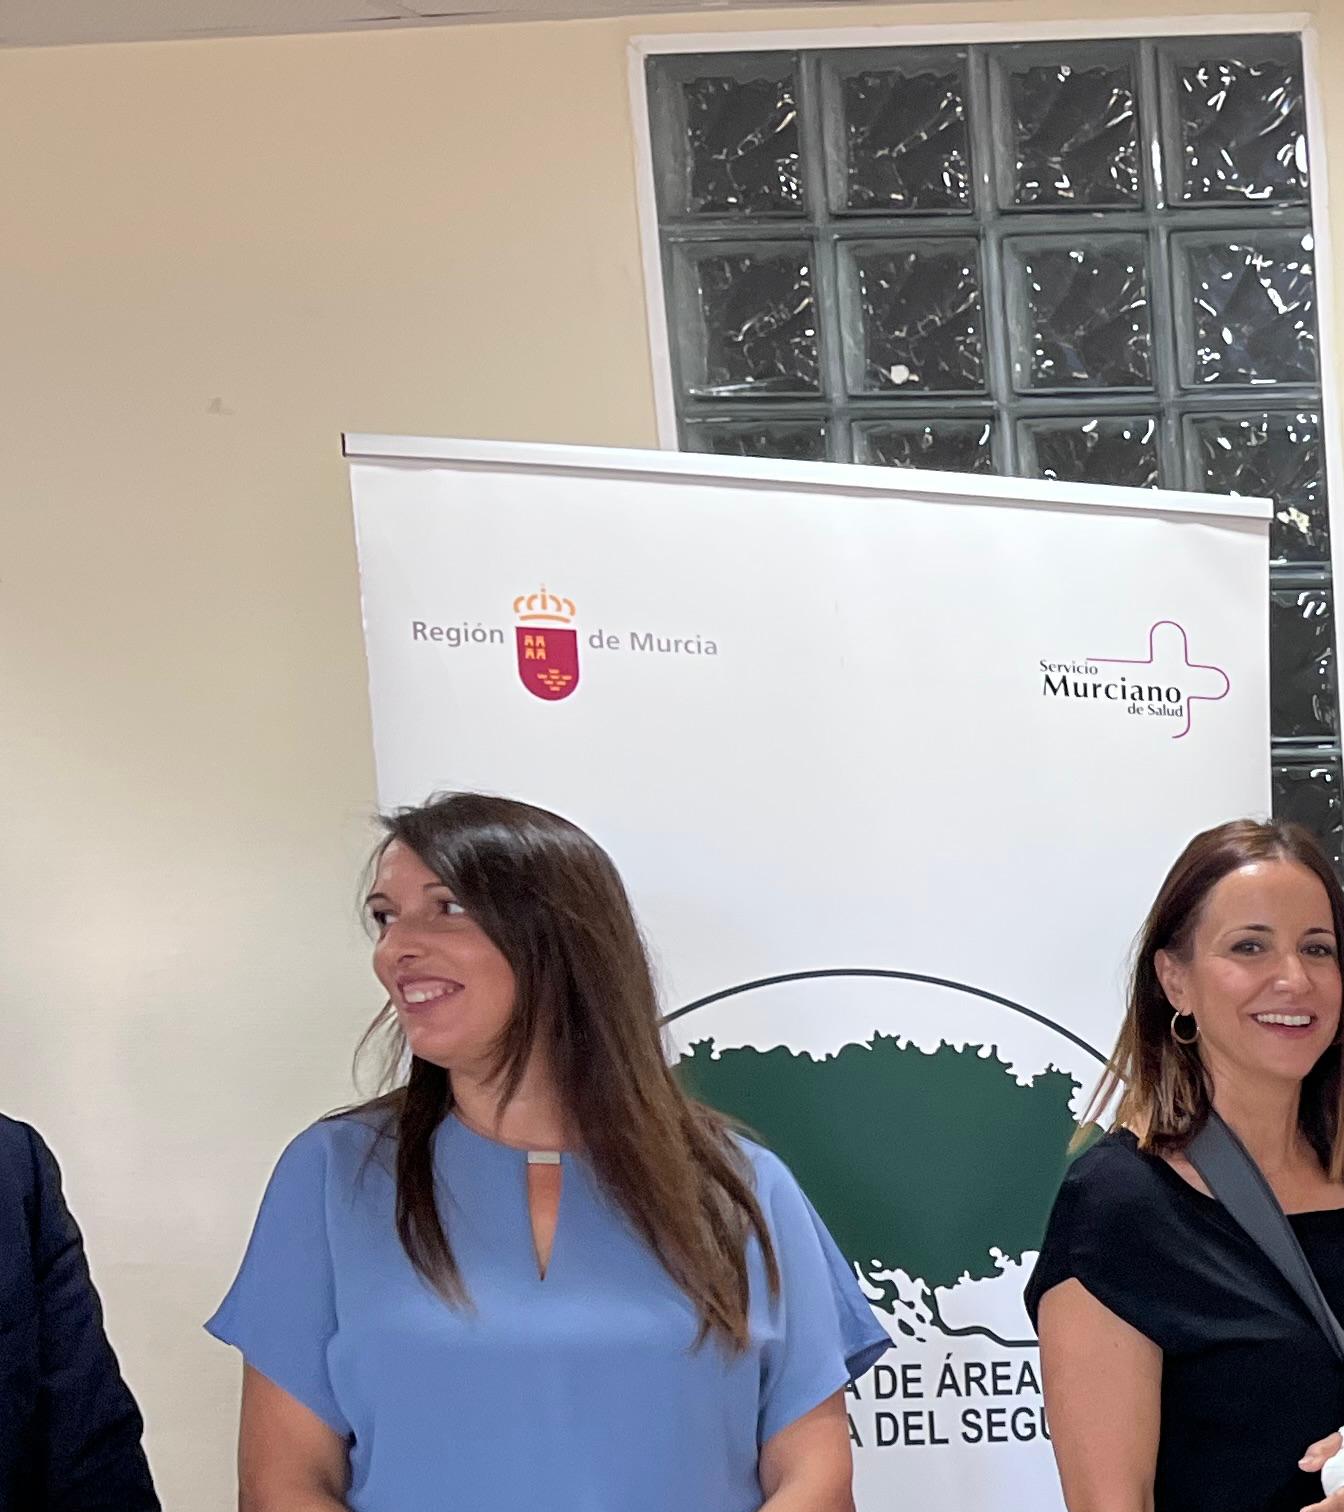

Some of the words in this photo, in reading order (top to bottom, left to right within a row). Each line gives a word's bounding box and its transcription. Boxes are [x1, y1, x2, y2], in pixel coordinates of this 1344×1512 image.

[412, 621, 505, 647] Región
[588, 628, 620, 650] de
[630, 630, 719, 656] Murcia
[1039, 659, 1099, 676] Servicio
[1043, 674, 1182, 704] Murciano
[1127, 702, 1144, 716] de
[1147, 703, 1184, 718] Salud
[874, 1364, 924, 1399] DE
[936, 1352, 1041, 1398] ÁREA
[875, 1410, 949, 1447] DEL
